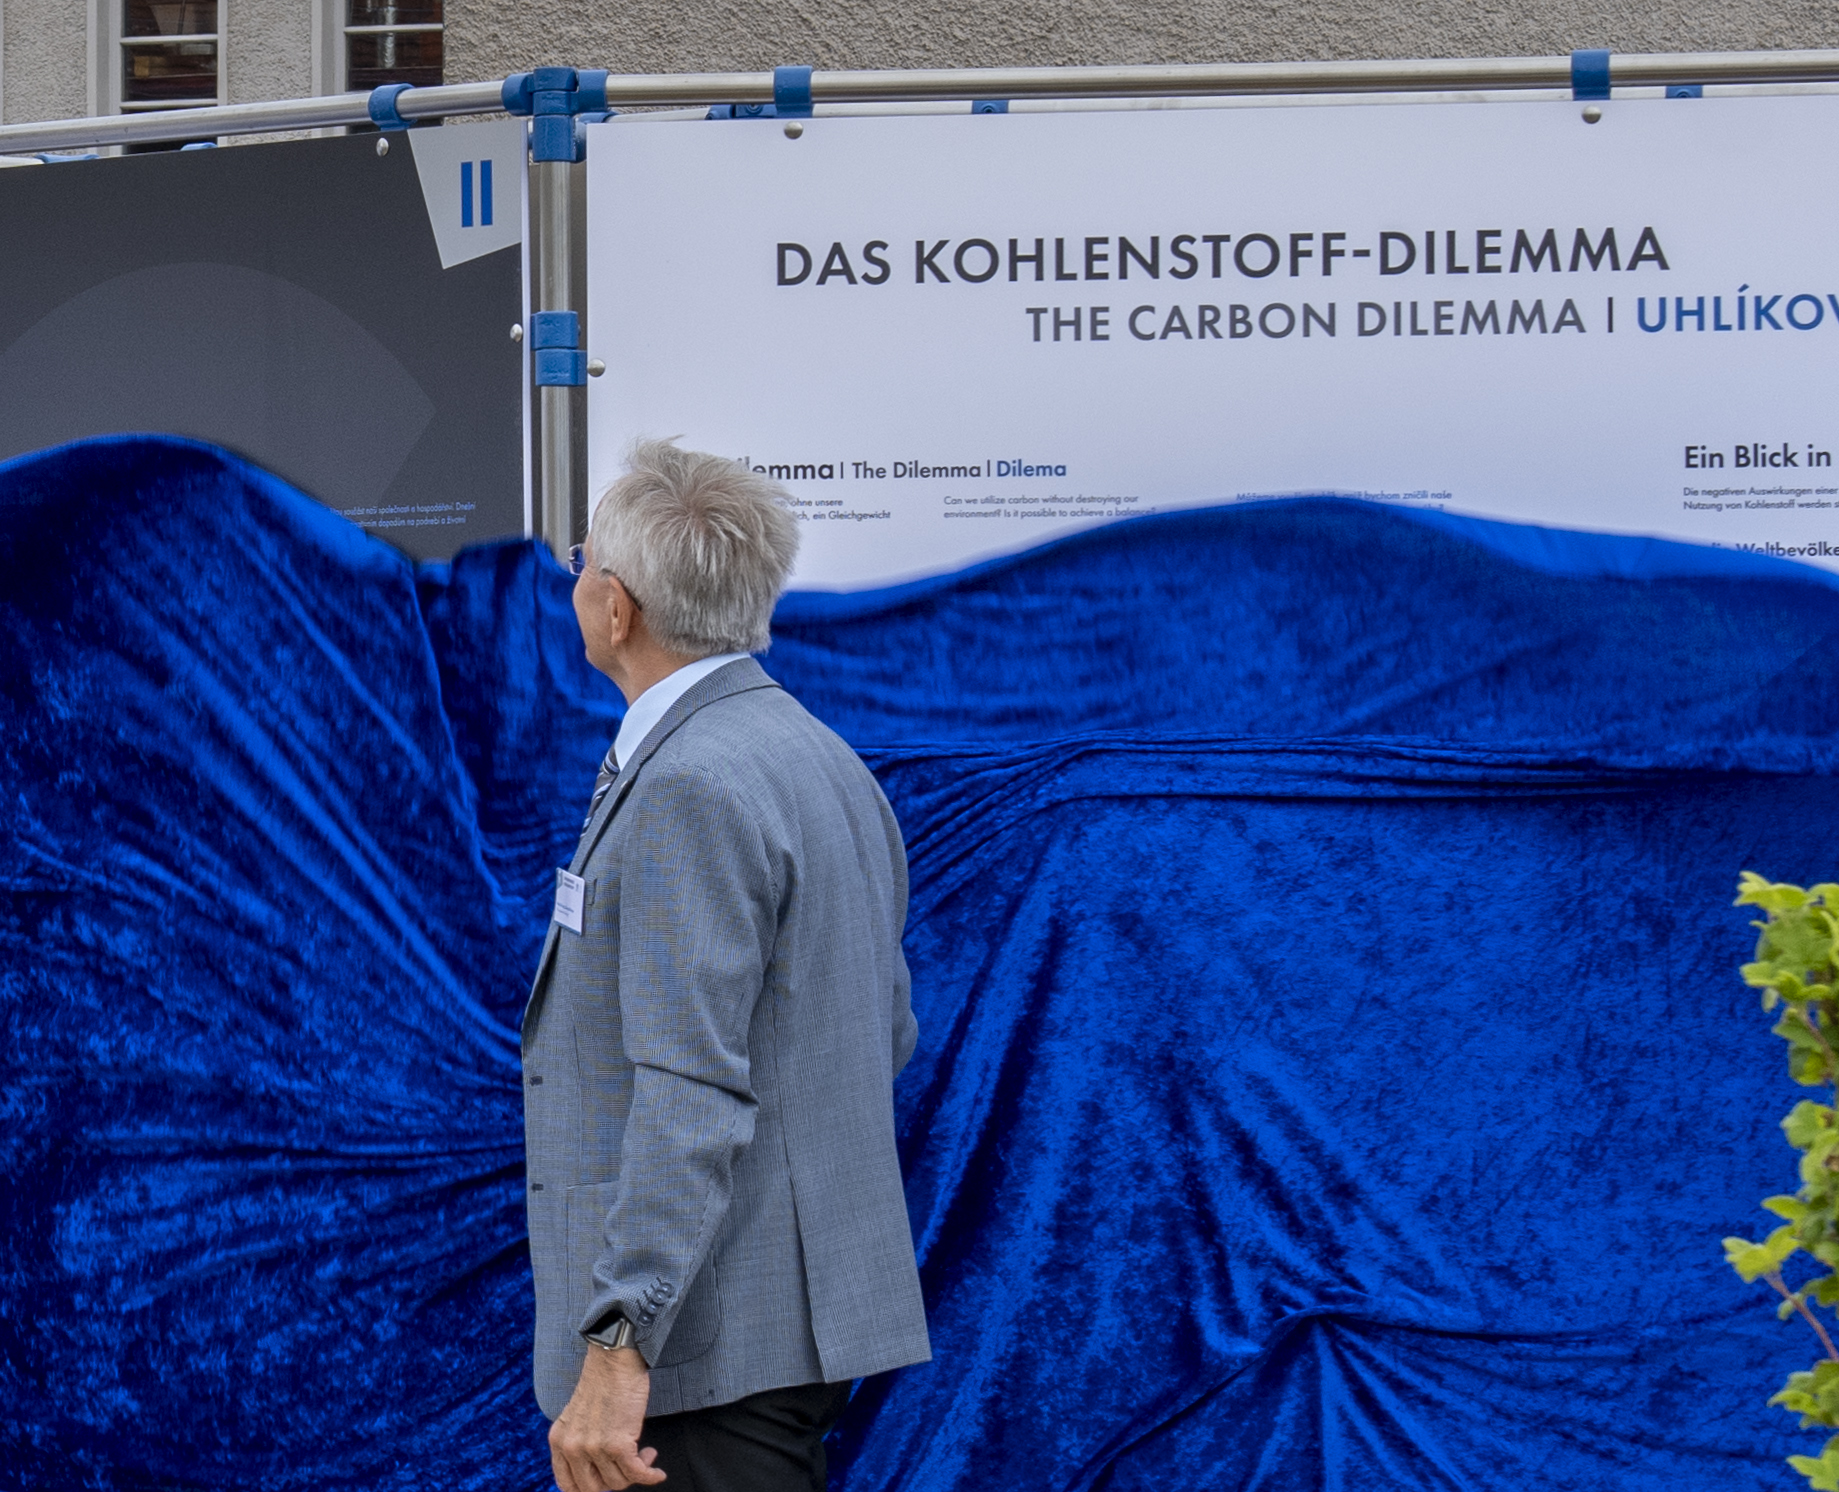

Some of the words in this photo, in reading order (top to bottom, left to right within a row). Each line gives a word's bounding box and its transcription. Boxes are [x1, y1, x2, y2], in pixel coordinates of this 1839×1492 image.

[459, 158, 495, 228] II
[776, 240, 891, 287] DAS
[914, 226, 1670, 286] KOHLENSTOFF-DILEMMA
[1025, 306, 1110, 343] THE
[1128, 302, 1336, 342] CARBON
[1357, 298, 1587, 337] DILEMMA
[851, 460, 887, 479] The
[893, 459, 981, 479] Dilemma
[996, 458, 1067, 478] Dilema
[1684, 444, 1724, 469] Ein
[1734, 442, 1799, 468] Blick
[1807, 443, 1832, 468] in
